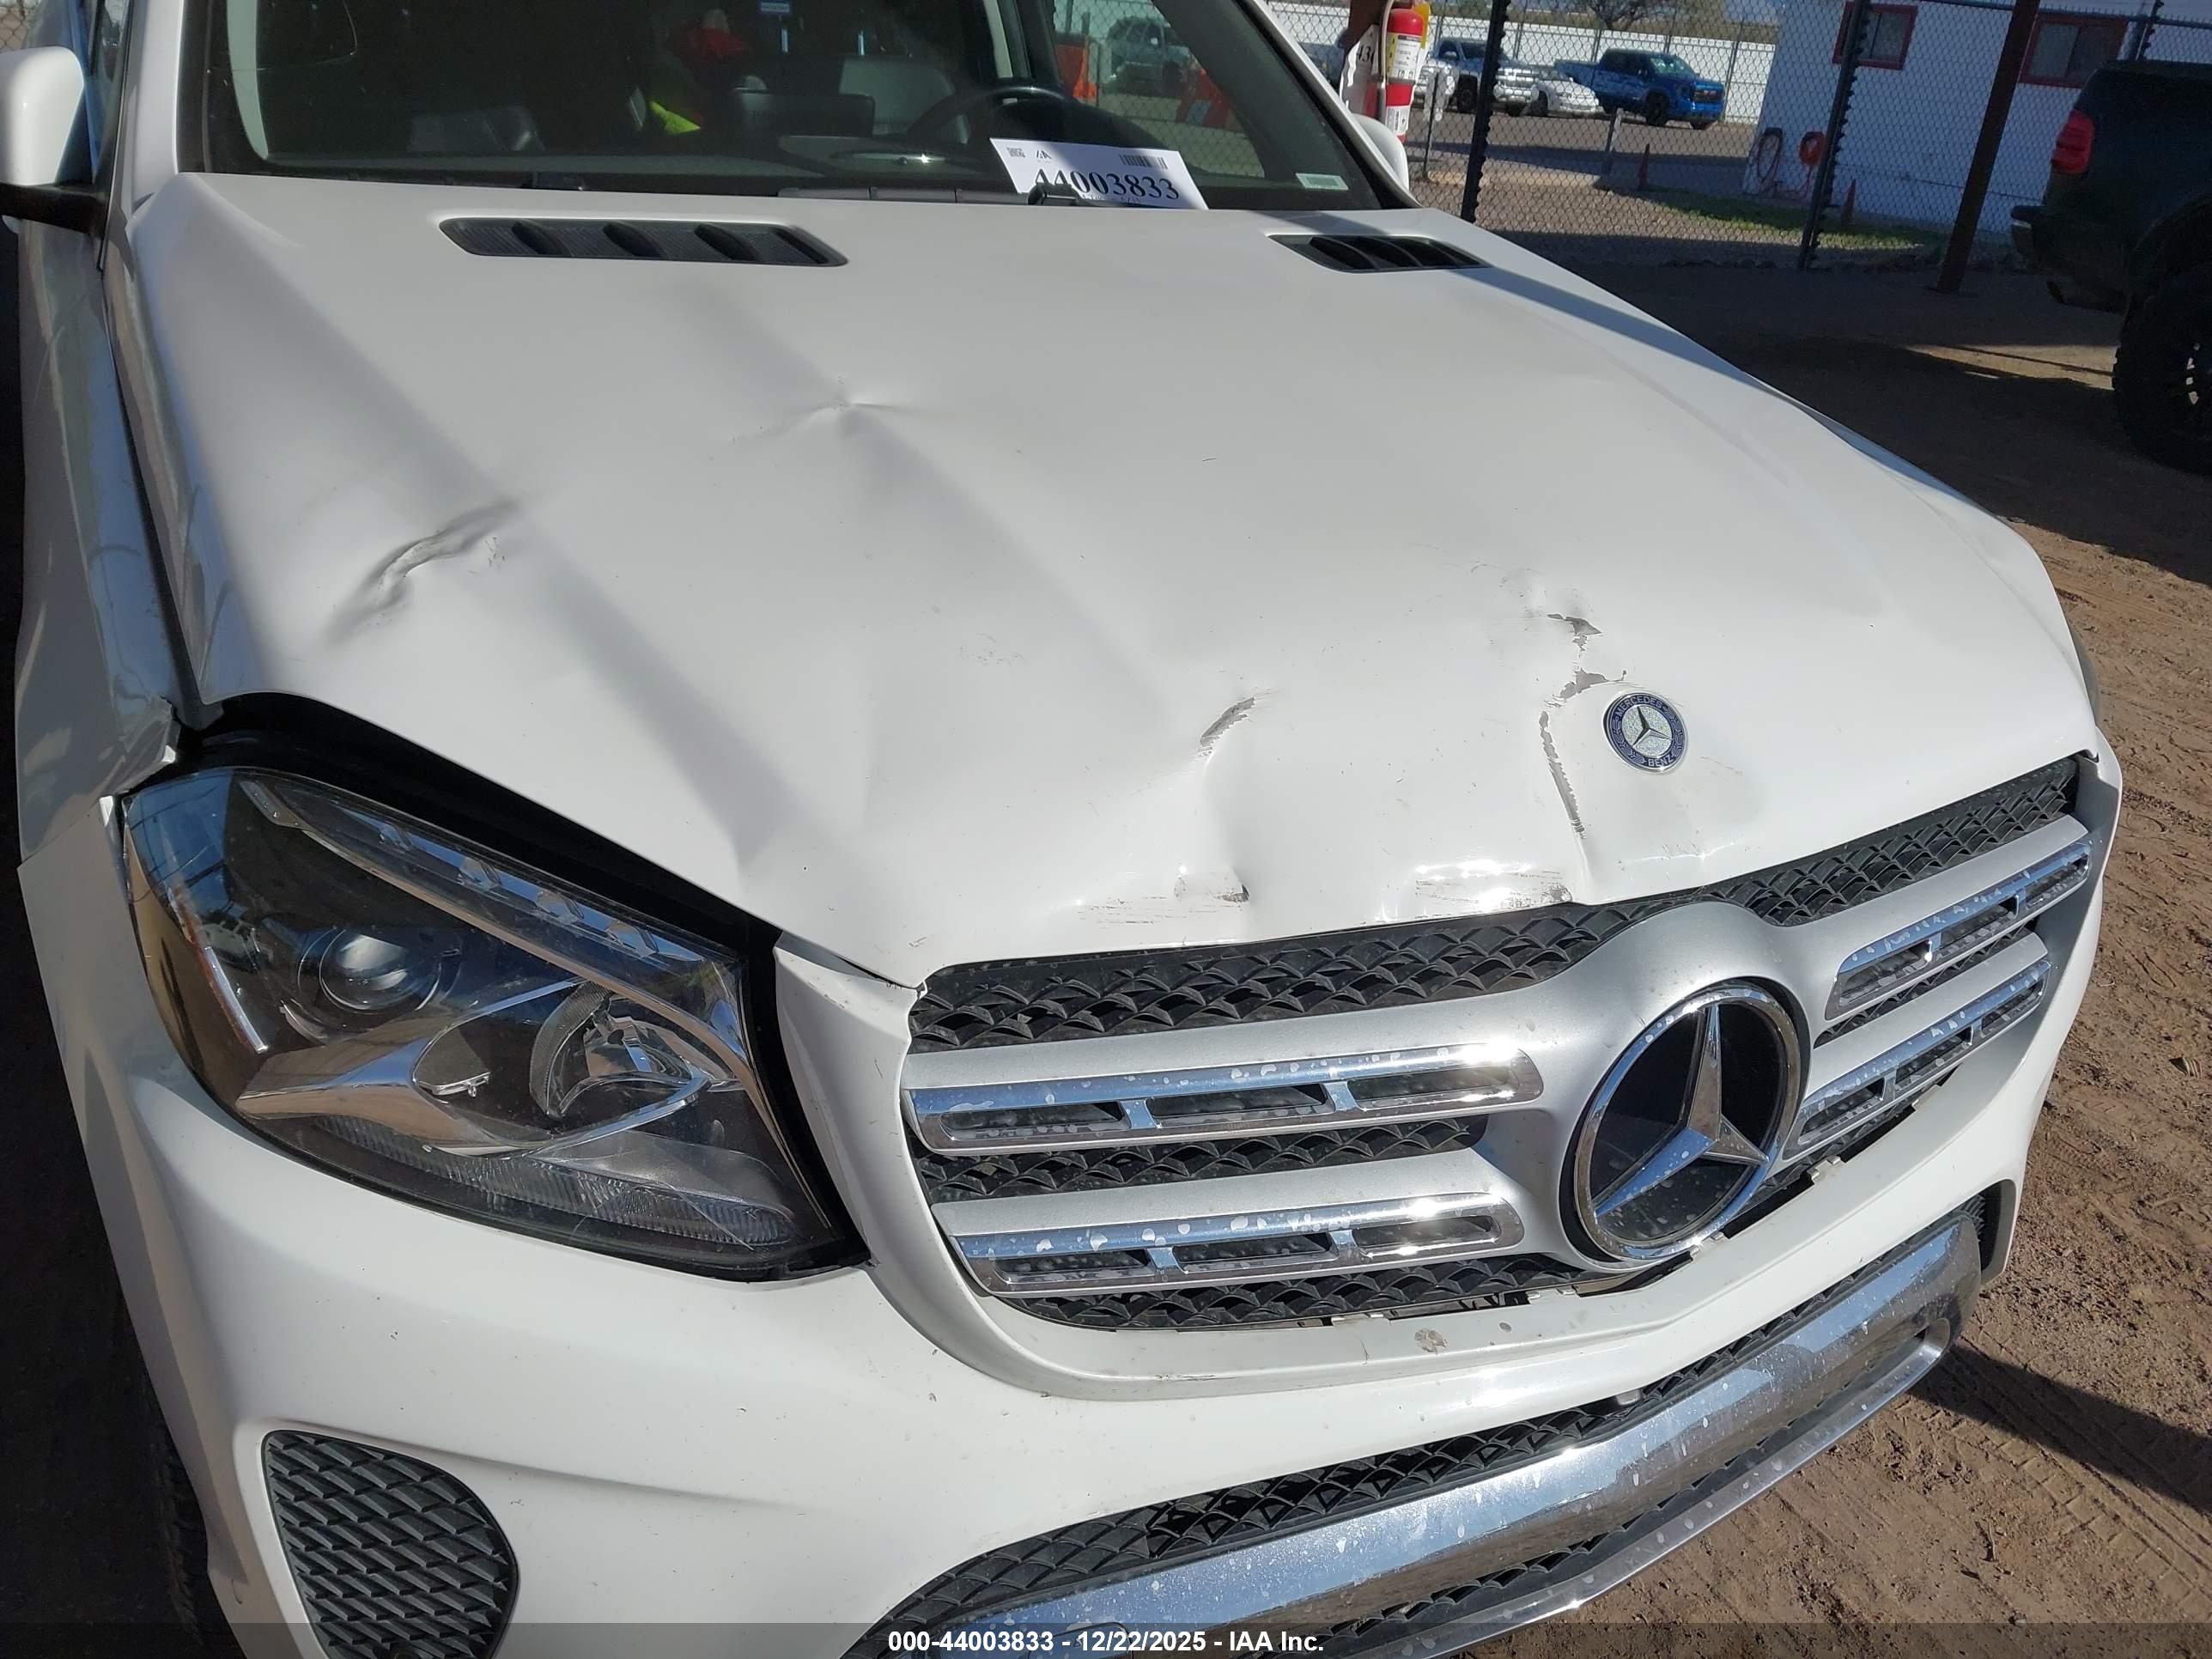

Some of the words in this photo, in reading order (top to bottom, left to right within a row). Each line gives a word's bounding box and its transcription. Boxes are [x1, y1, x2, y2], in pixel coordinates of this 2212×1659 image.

[1035, 168, 1180, 200] 44003833
[1615, 696, 1662, 718] MERCEDES
[1648, 756, 1674, 767] BENZ
